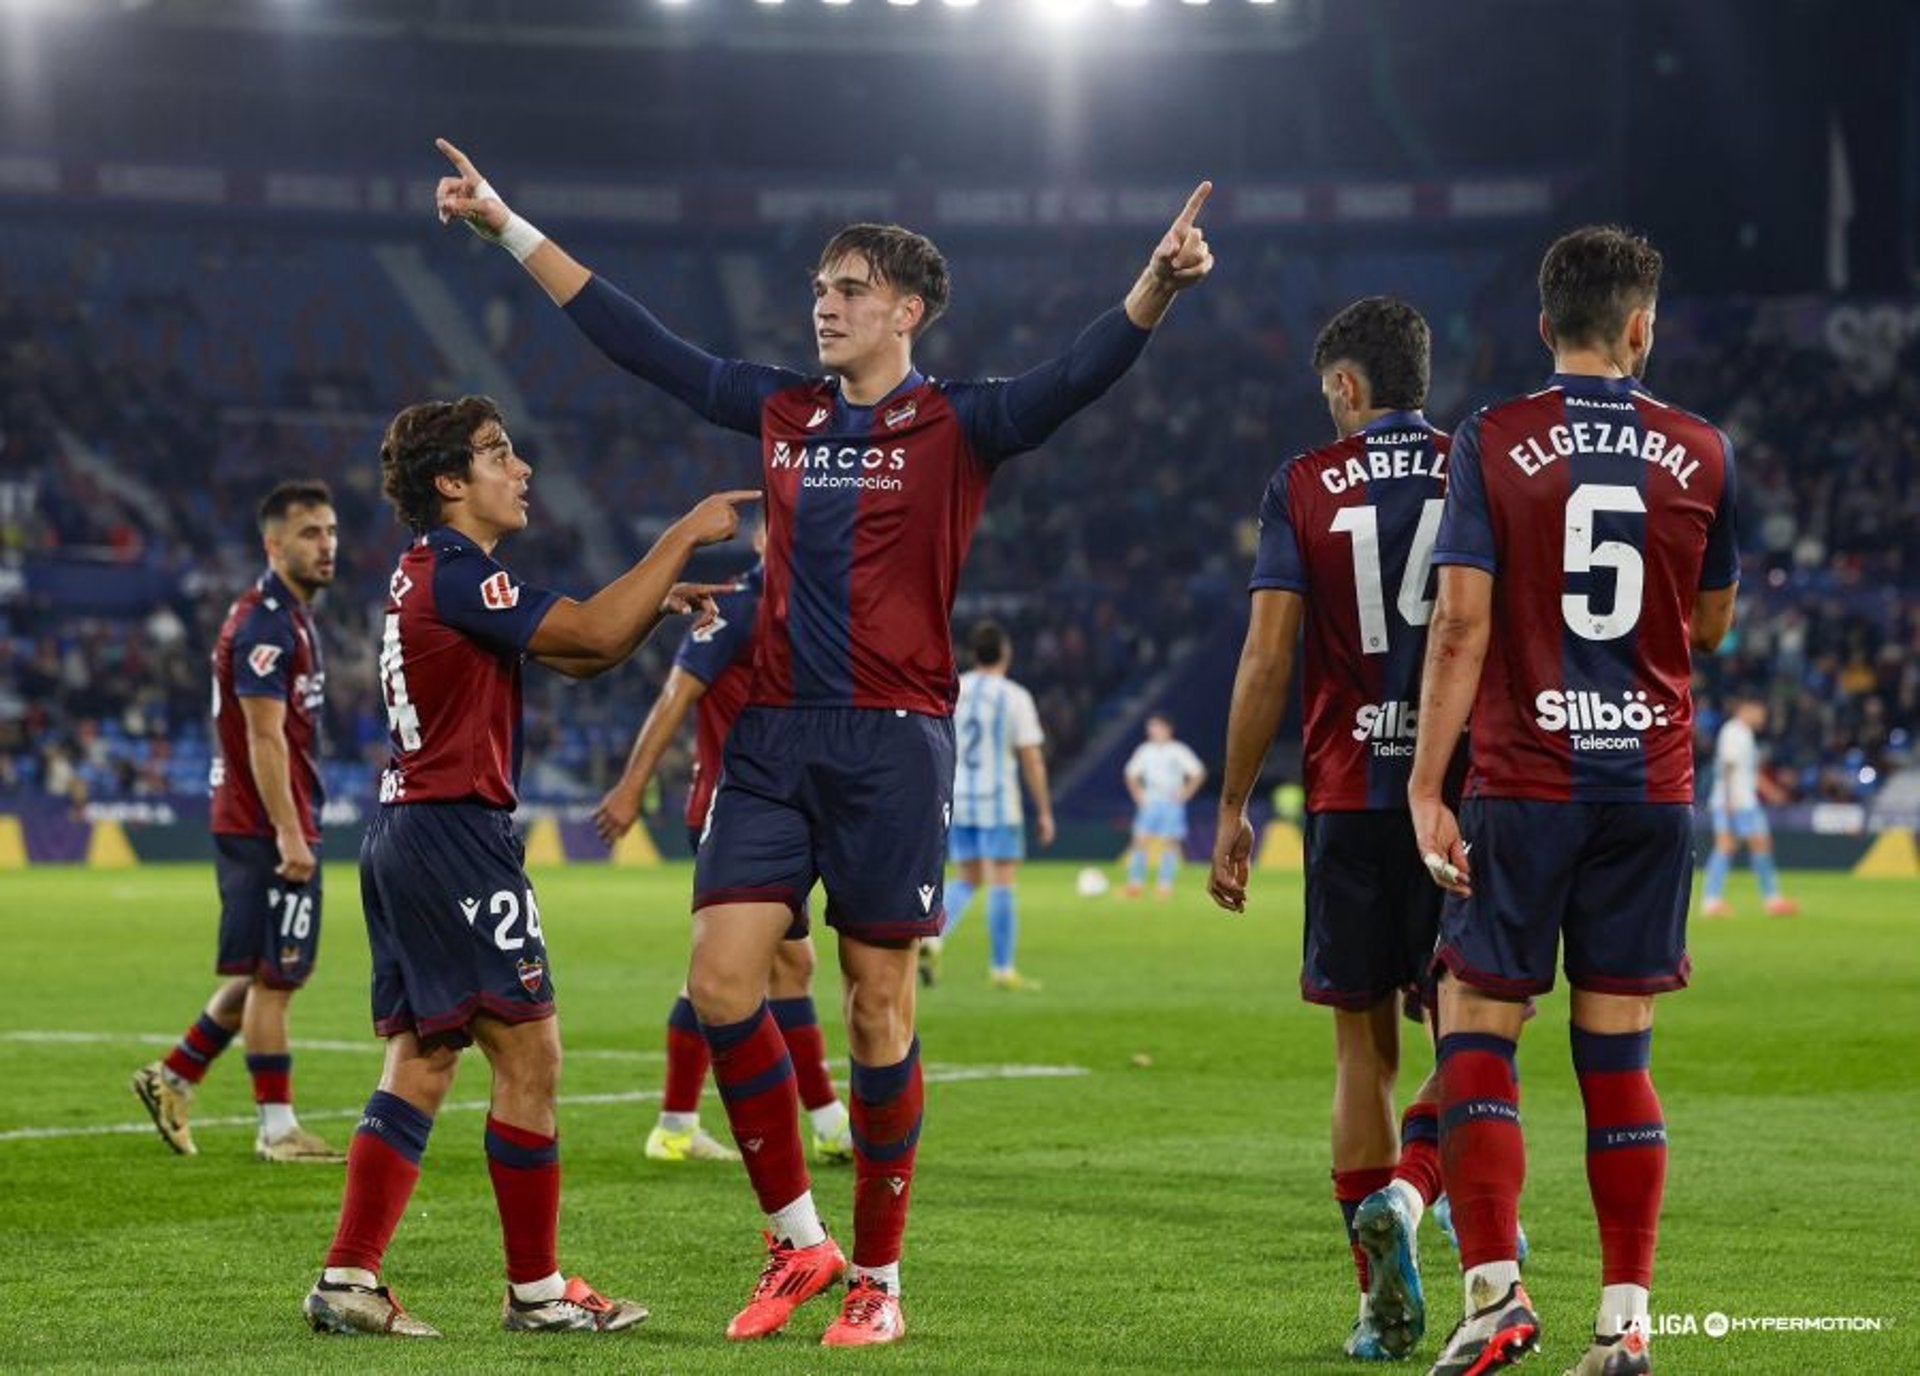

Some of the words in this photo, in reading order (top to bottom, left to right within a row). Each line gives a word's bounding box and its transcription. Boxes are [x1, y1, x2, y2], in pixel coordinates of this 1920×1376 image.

[771, 441, 906, 470] MARCOS
[1508, 422, 1700, 490] ELGEZABAL
[803, 472, 903, 491] automoción
[1561, 484, 1648, 641] 5
[1569, 734, 1640, 750] Telecom
[281, 894, 313, 939] 16
[490, 889, 545, 950] 24
